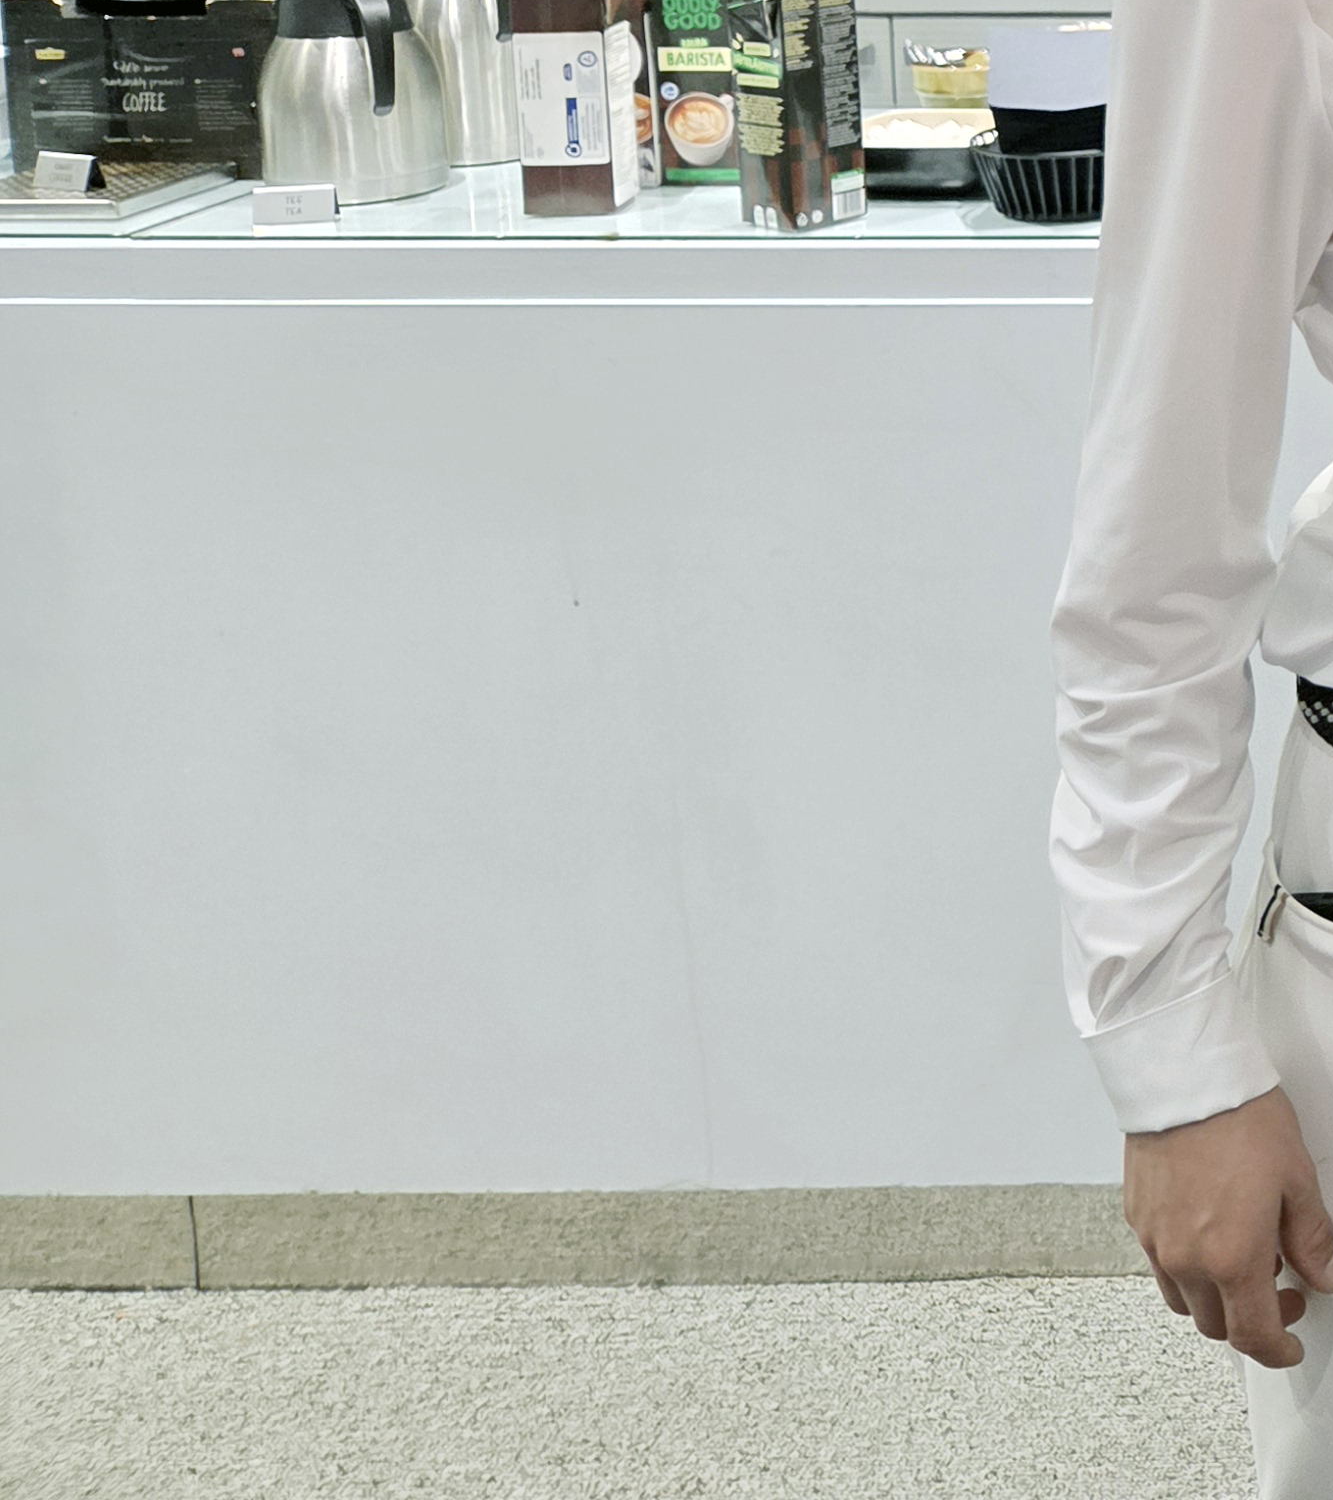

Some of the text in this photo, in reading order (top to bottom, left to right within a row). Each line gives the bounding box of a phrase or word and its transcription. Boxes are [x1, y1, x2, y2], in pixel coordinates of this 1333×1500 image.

[664, 12, 722, 31] GOOD
[667, 52, 726, 67] BARISTA
[122, 91, 167, 113] COFFEE
